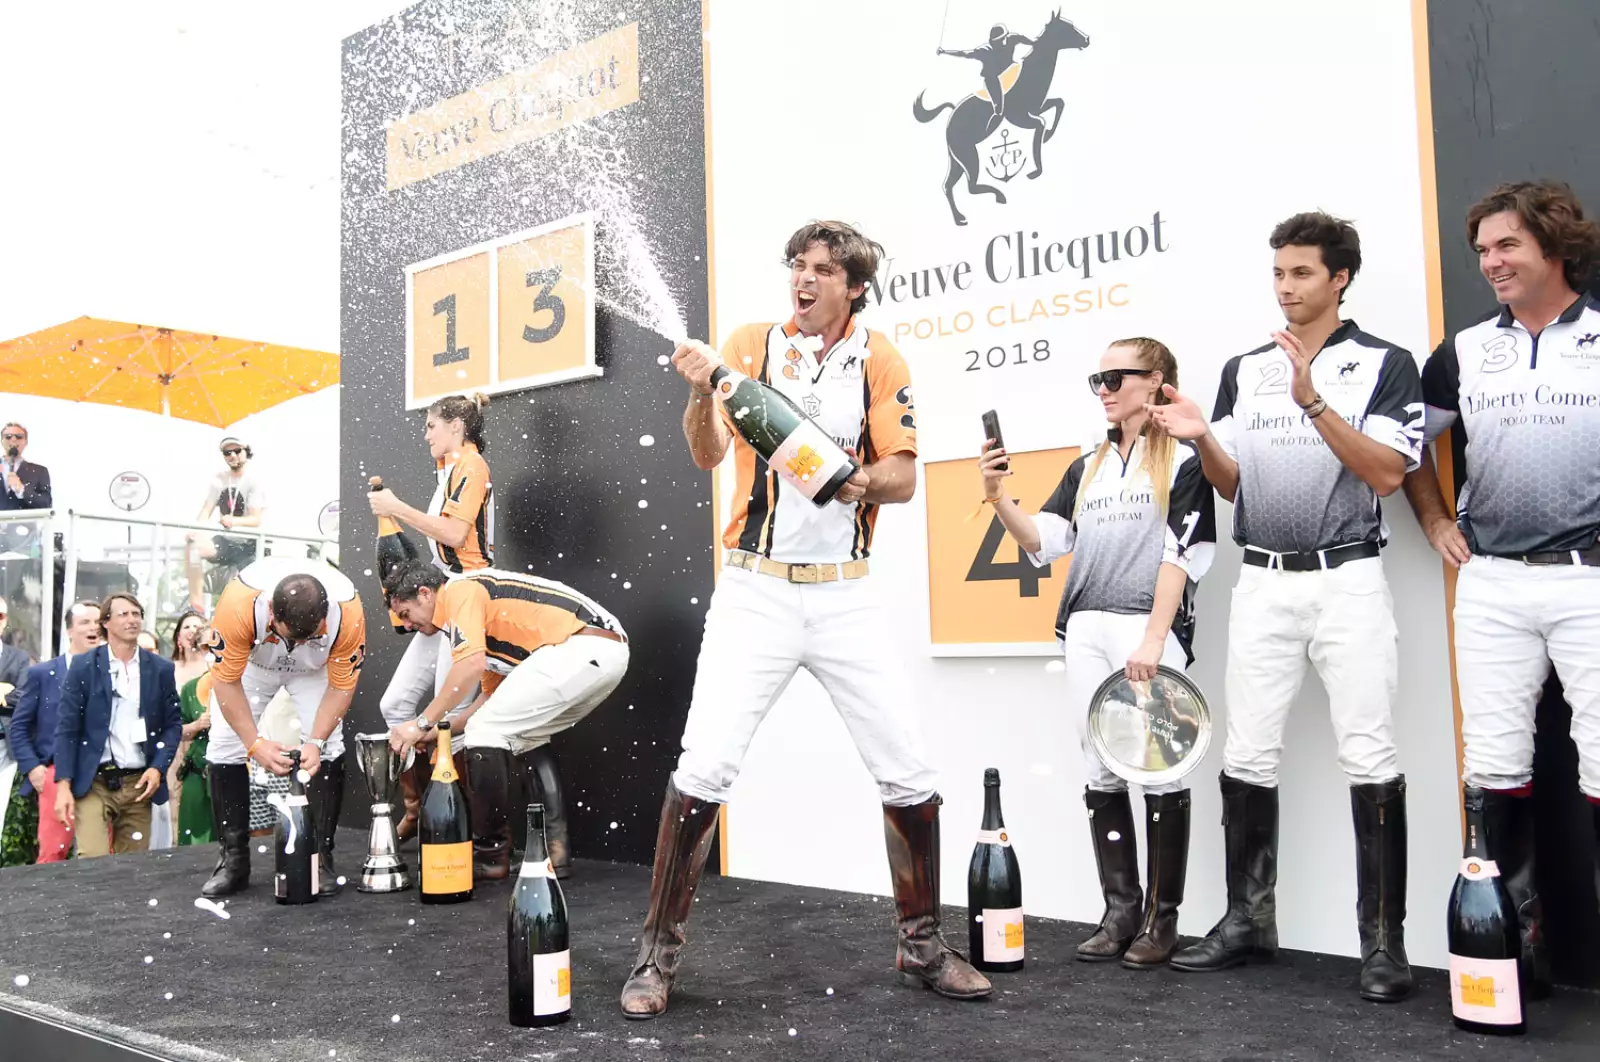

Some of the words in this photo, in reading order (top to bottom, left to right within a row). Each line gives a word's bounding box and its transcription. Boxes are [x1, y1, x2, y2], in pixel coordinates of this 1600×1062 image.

[867, 257, 972, 307] Veuve
[985, 211, 1170, 284] Clicquot
[432, 293, 470, 367] 1
[522, 265, 566, 343] 3
[895, 311, 974, 343] POLO
[986, 283, 1131, 328] CLASSIC
[964, 339, 1051, 372] 2018
[1480, 333, 1519, 374] 3
[1467, 391, 1528, 415] Liberty
[1500, 416, 1528, 427] POLO
[1532, 414, 1566, 425] TEAM
[1244, 410, 1296, 434] Liberty
[1271, 436, 1296, 447] POLO
[965, 499, 1052, 598] 4
